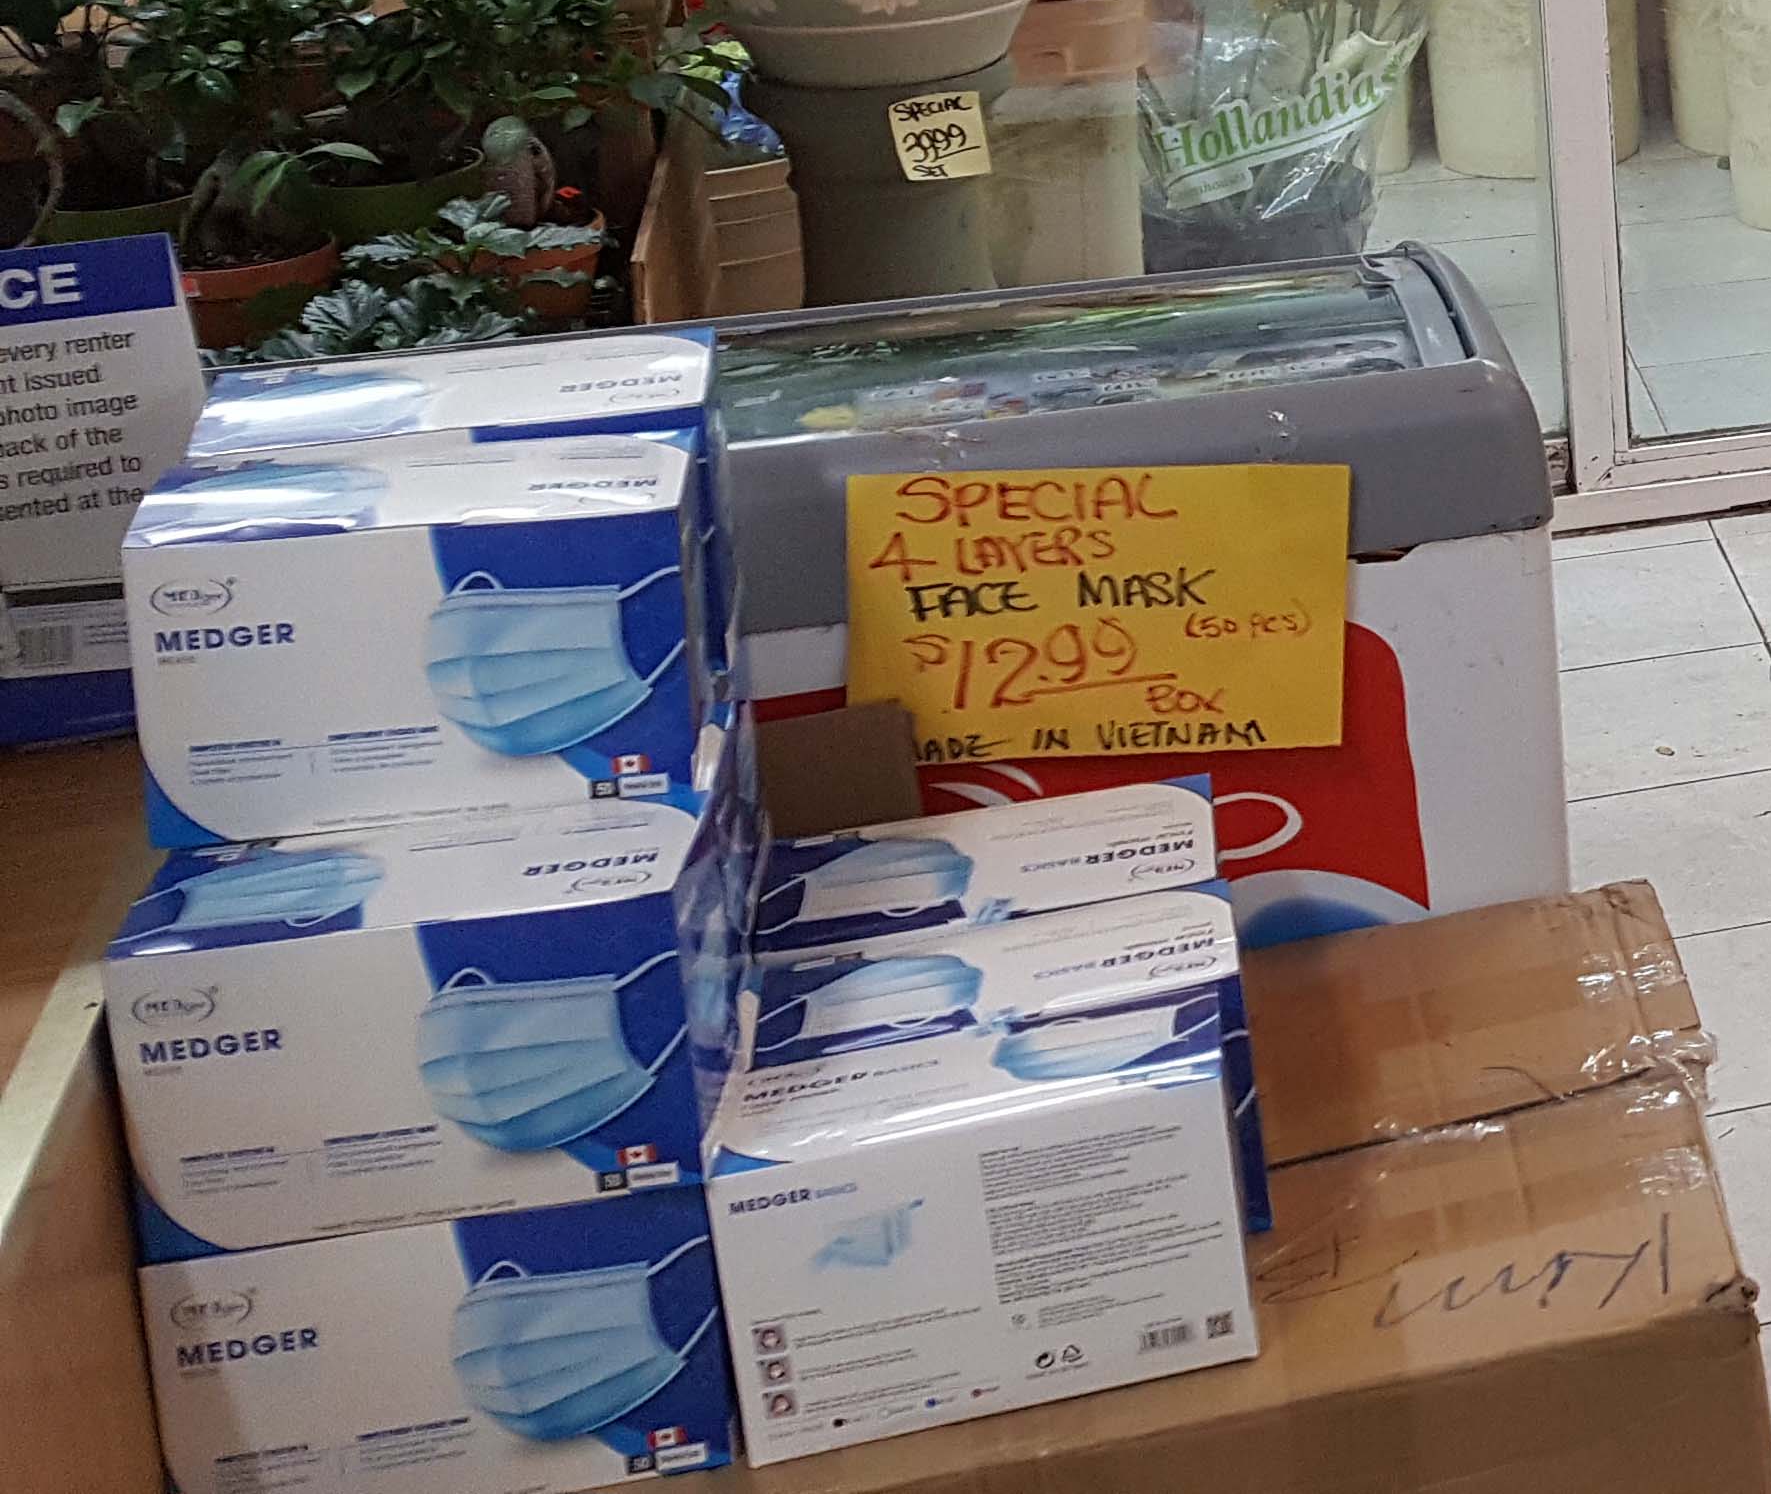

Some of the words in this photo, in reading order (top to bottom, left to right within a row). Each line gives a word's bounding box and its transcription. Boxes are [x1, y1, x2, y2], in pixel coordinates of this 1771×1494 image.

[892, 96, 973, 121] SPECIAL
[1155, 70, 1379, 174] Hollandia
[65, 332, 135, 356] renter
[25, 365, 103, 391] issued
[559, 373, 683, 393] MEDGER
[66, 395, 138, 417] image
[56, 428, 79, 450] of
[85, 427, 123, 446] the
[17, 456, 112, 487] required
[120, 454, 142, 473] to
[527, 478, 658, 491] MEDGER
[78, 492, 101, 510] at
[896, 473, 1179, 527] SPECIAL
[869, 532, 937, 580] 4
[953, 526, 1116, 577] LAYERS
[906, 579, 1039, 622] FACE
[1077, 568, 1217, 609] MASK
[154, 623, 296, 652] MEDGER
[1144, 684, 1225, 714] BOX
[1031, 728, 1070, 751] IN
[1095, 718, 1267, 751] VIETNAM
[522, 853, 660, 876] MEDGER
[1085, 839, 1194, 865] MEDGER
[1101, 938, 1215, 969] MEDGER
[139, 1029, 284, 1064] MEDGER
[729, 1189, 811, 1215] MEDGER
[177, 1328, 319, 1368] MEDGER
